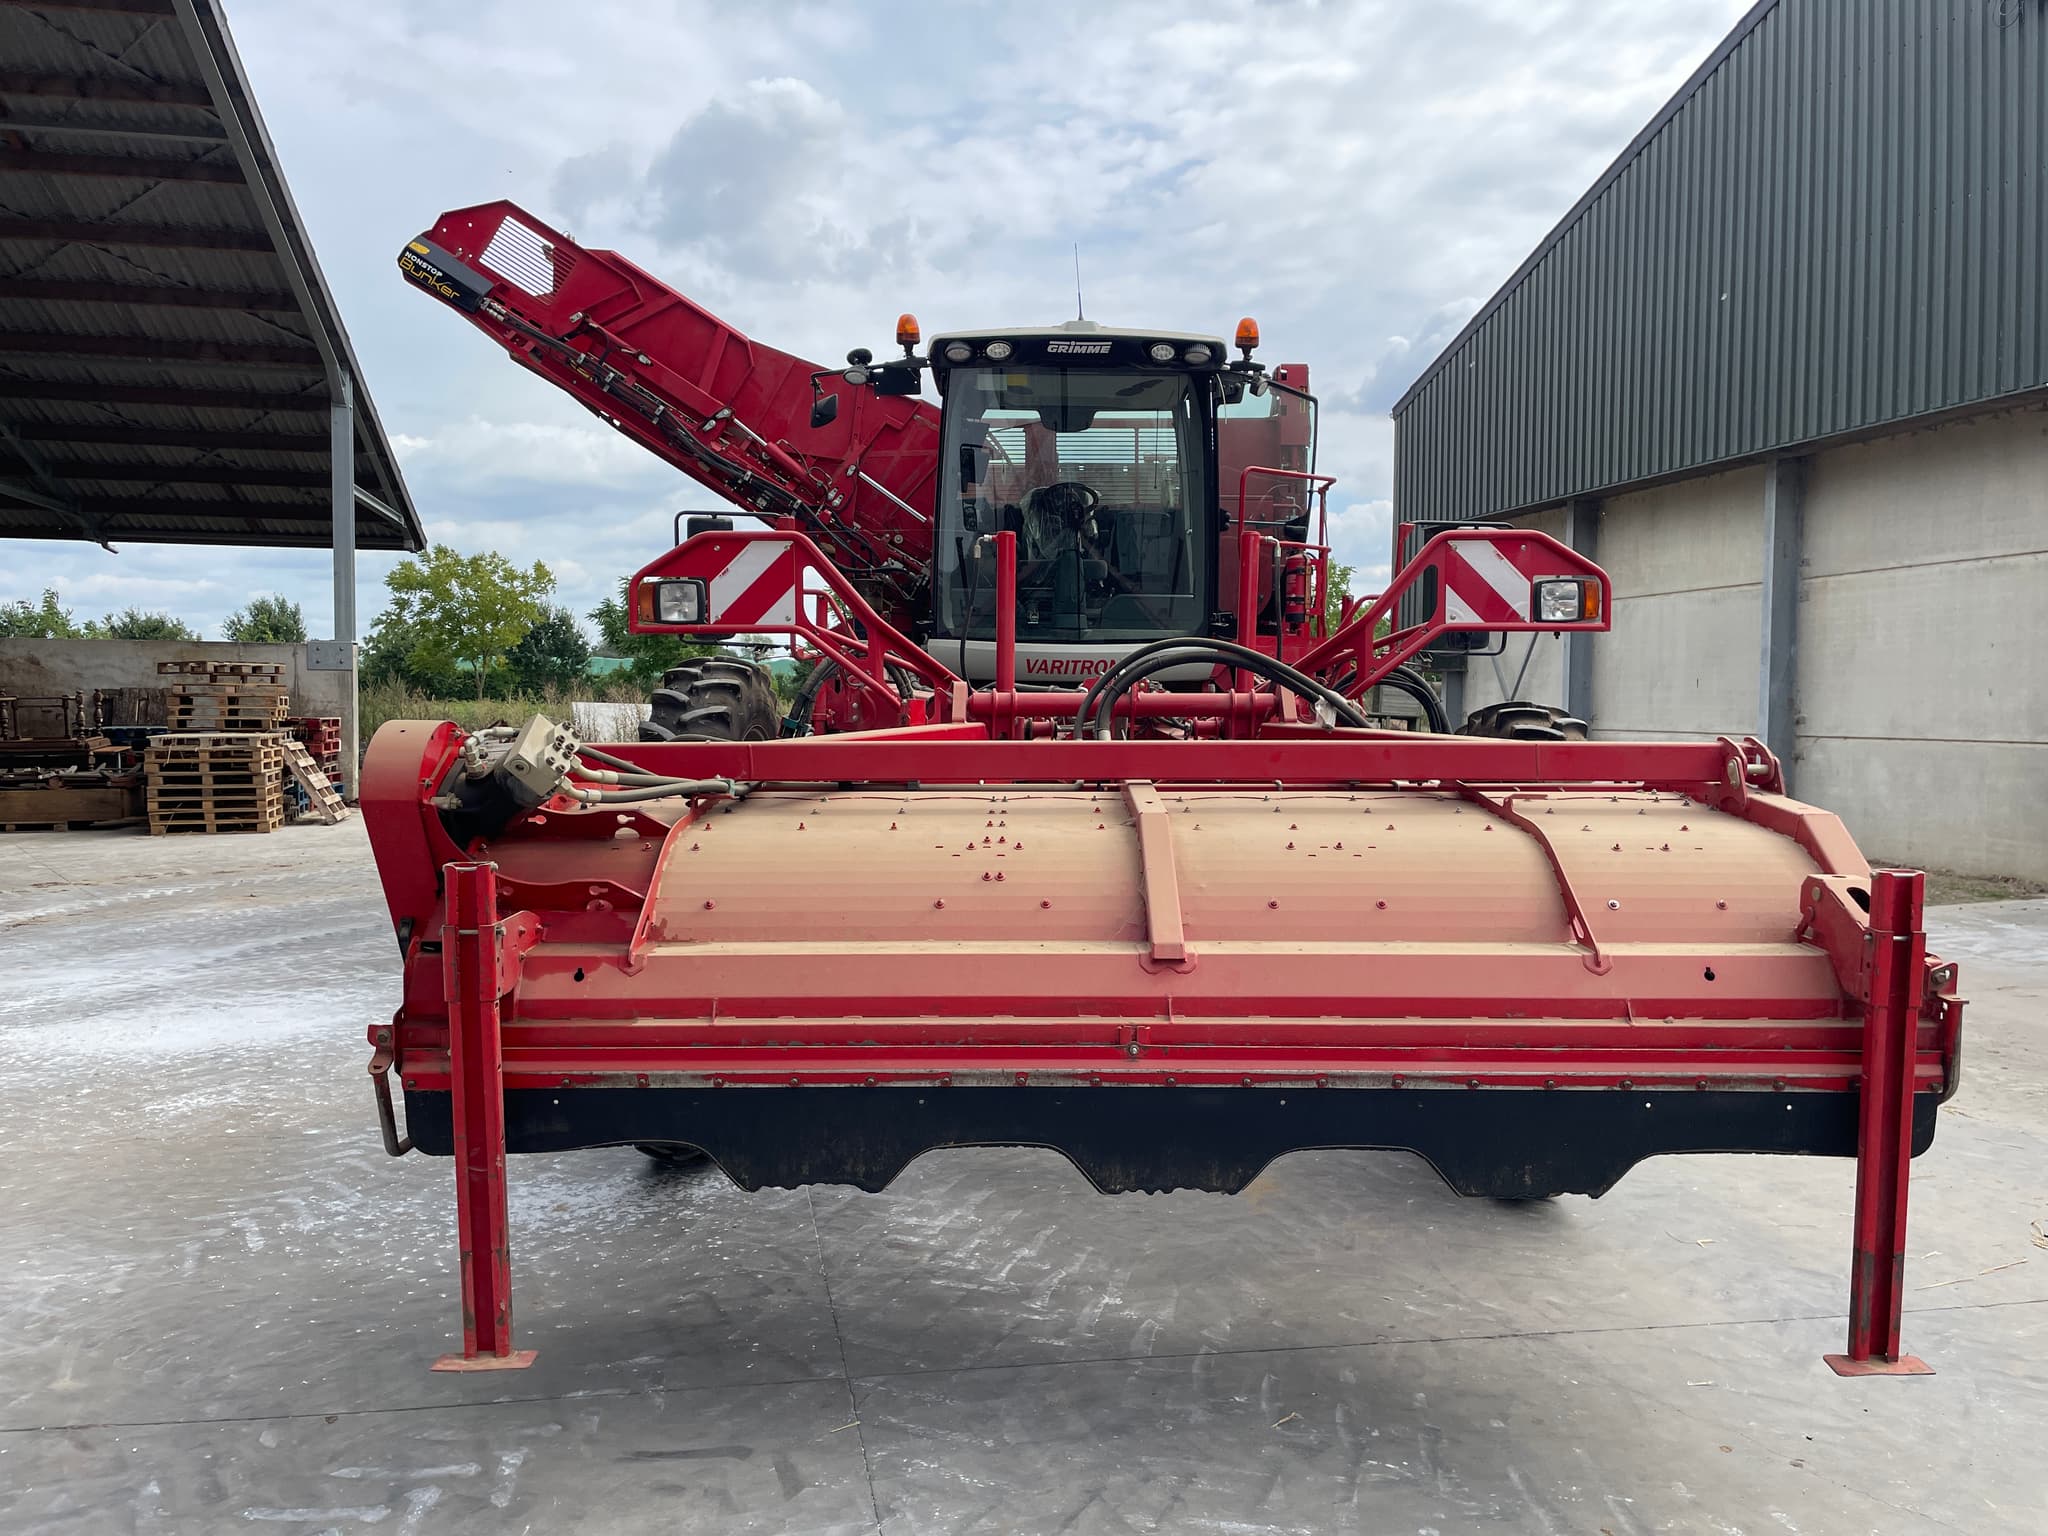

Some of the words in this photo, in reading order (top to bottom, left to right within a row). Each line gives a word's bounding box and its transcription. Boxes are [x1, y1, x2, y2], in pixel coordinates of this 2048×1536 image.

[404, 251, 443, 277] NONSTOP
[399, 256, 460, 299] Bunker
[1047, 341, 1112, 354] GRIMME
